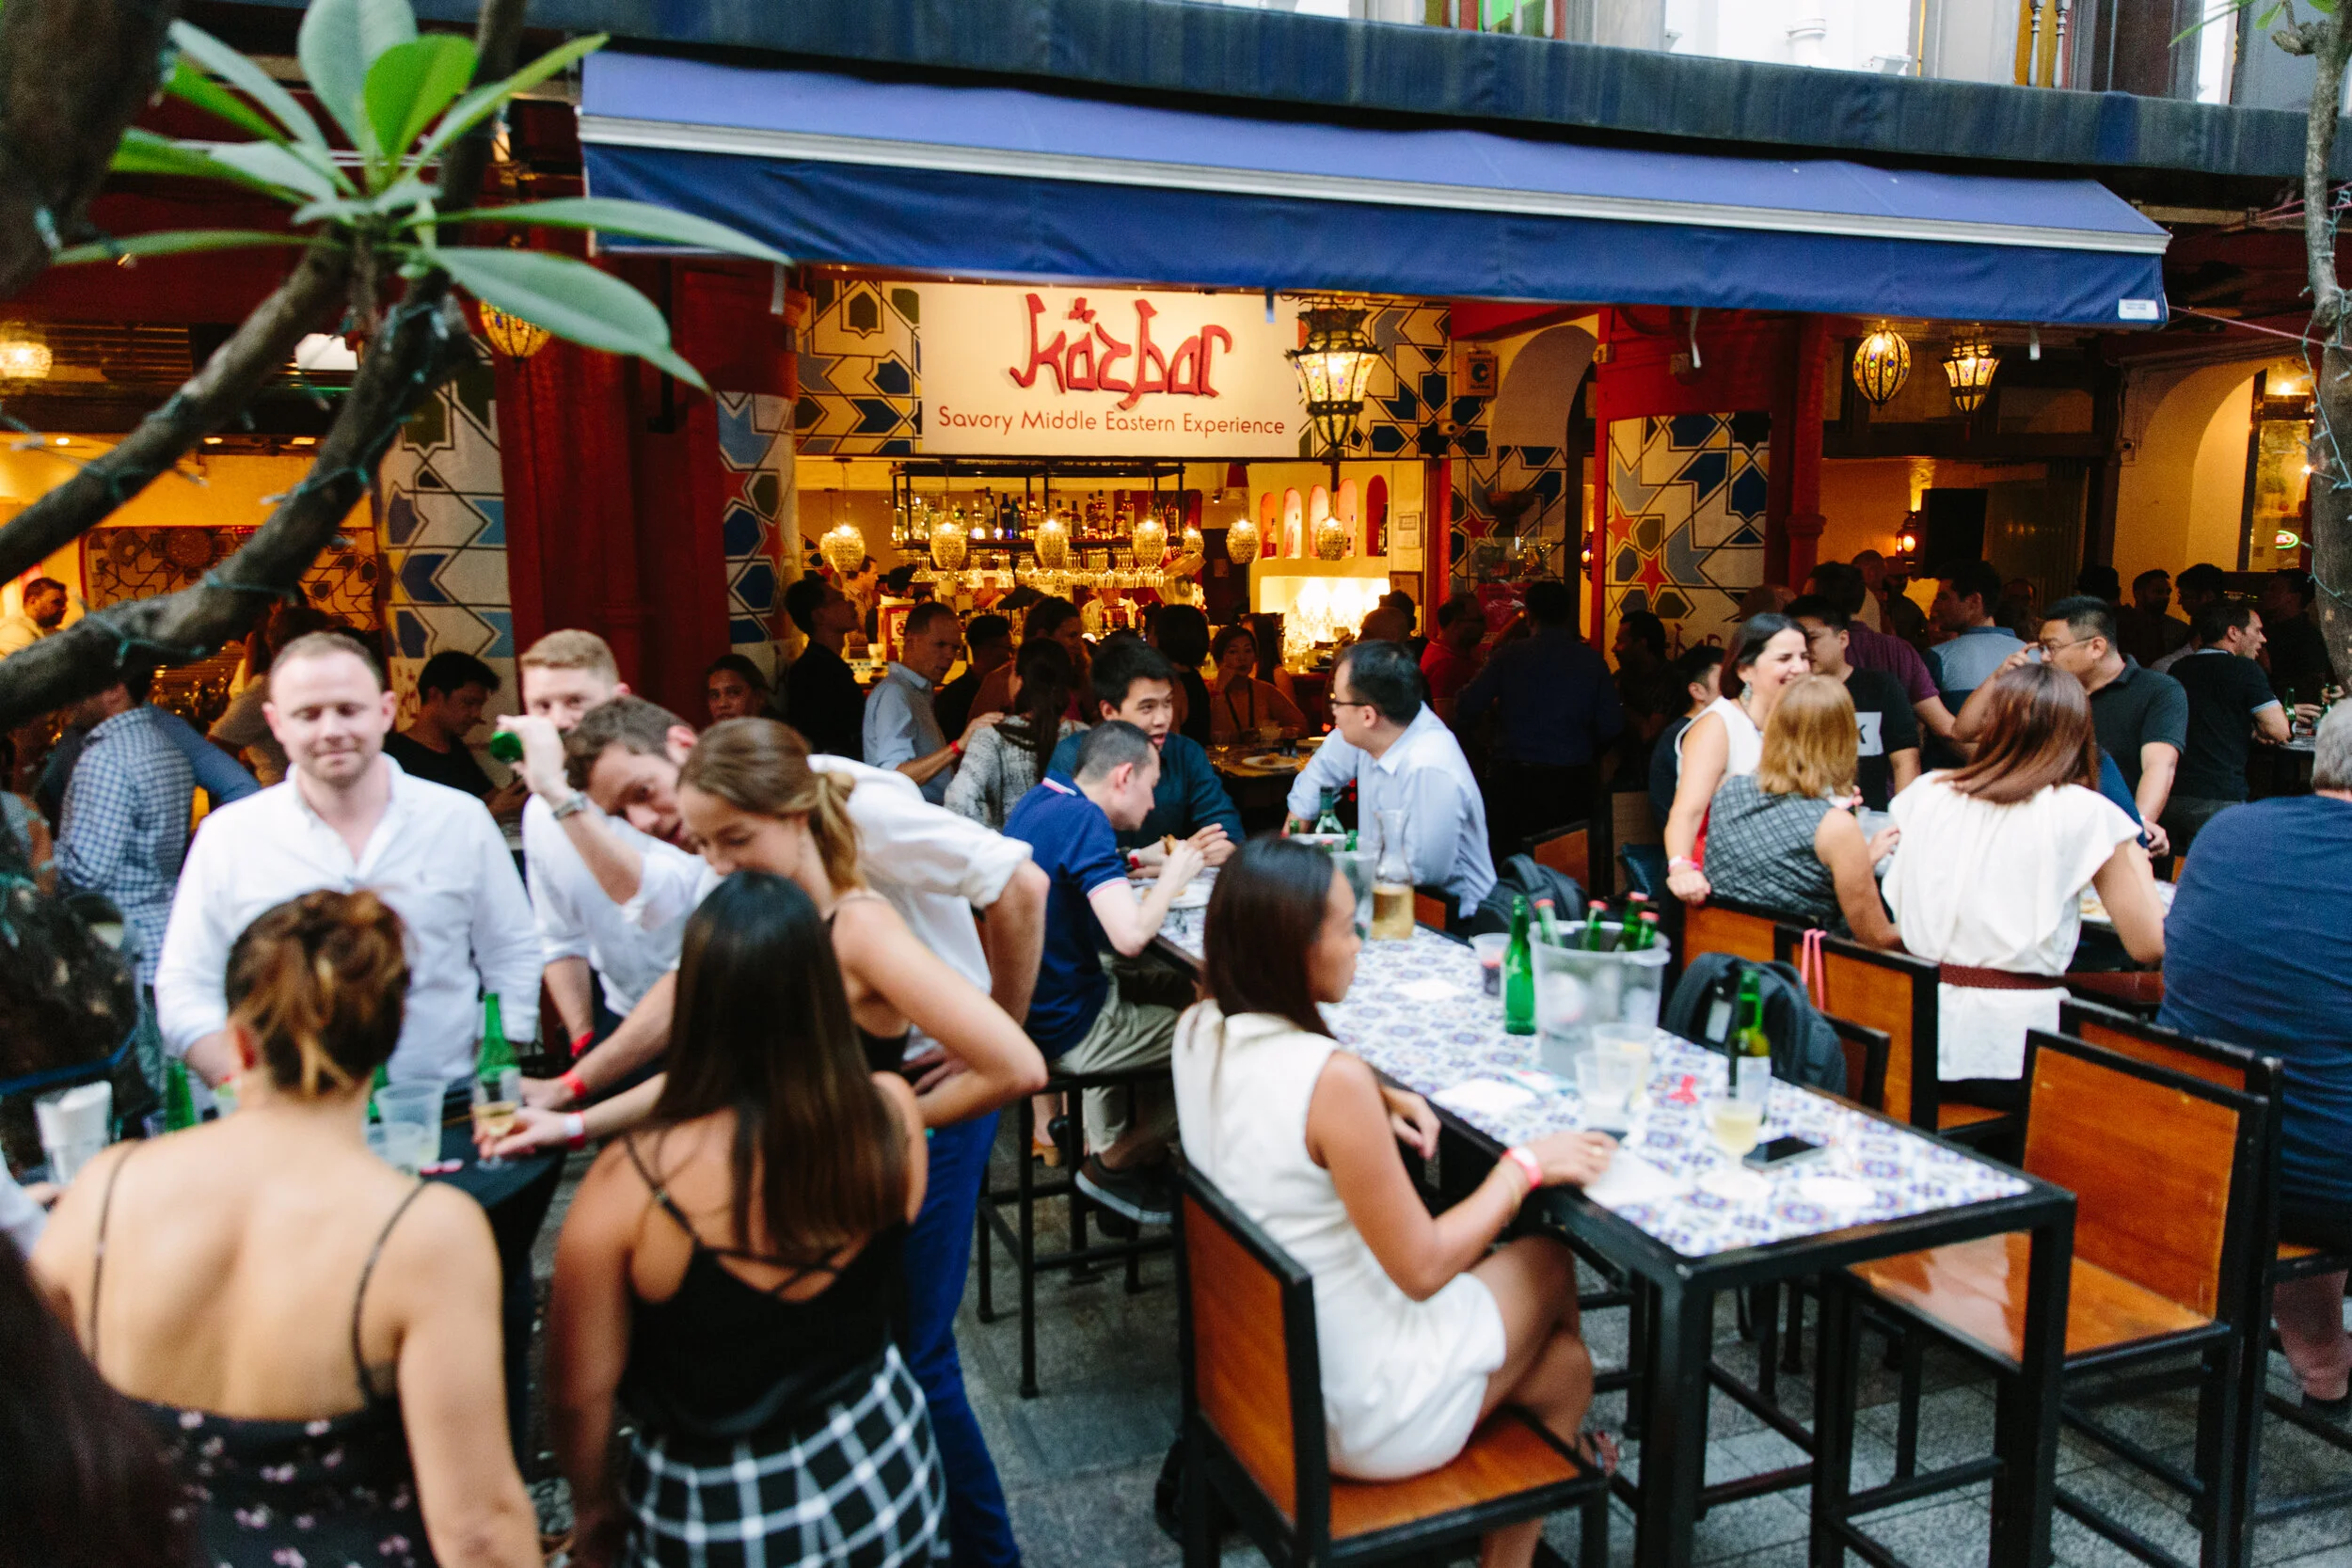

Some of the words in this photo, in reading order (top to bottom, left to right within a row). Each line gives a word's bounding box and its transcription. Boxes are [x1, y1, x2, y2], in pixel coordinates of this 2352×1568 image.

[939, 405, 1013, 435] Savory
[1020, 411, 1096, 430] Middle
[1106, 411, 1174, 433] Eastern
[1184, 414, 1285, 437] Experience
